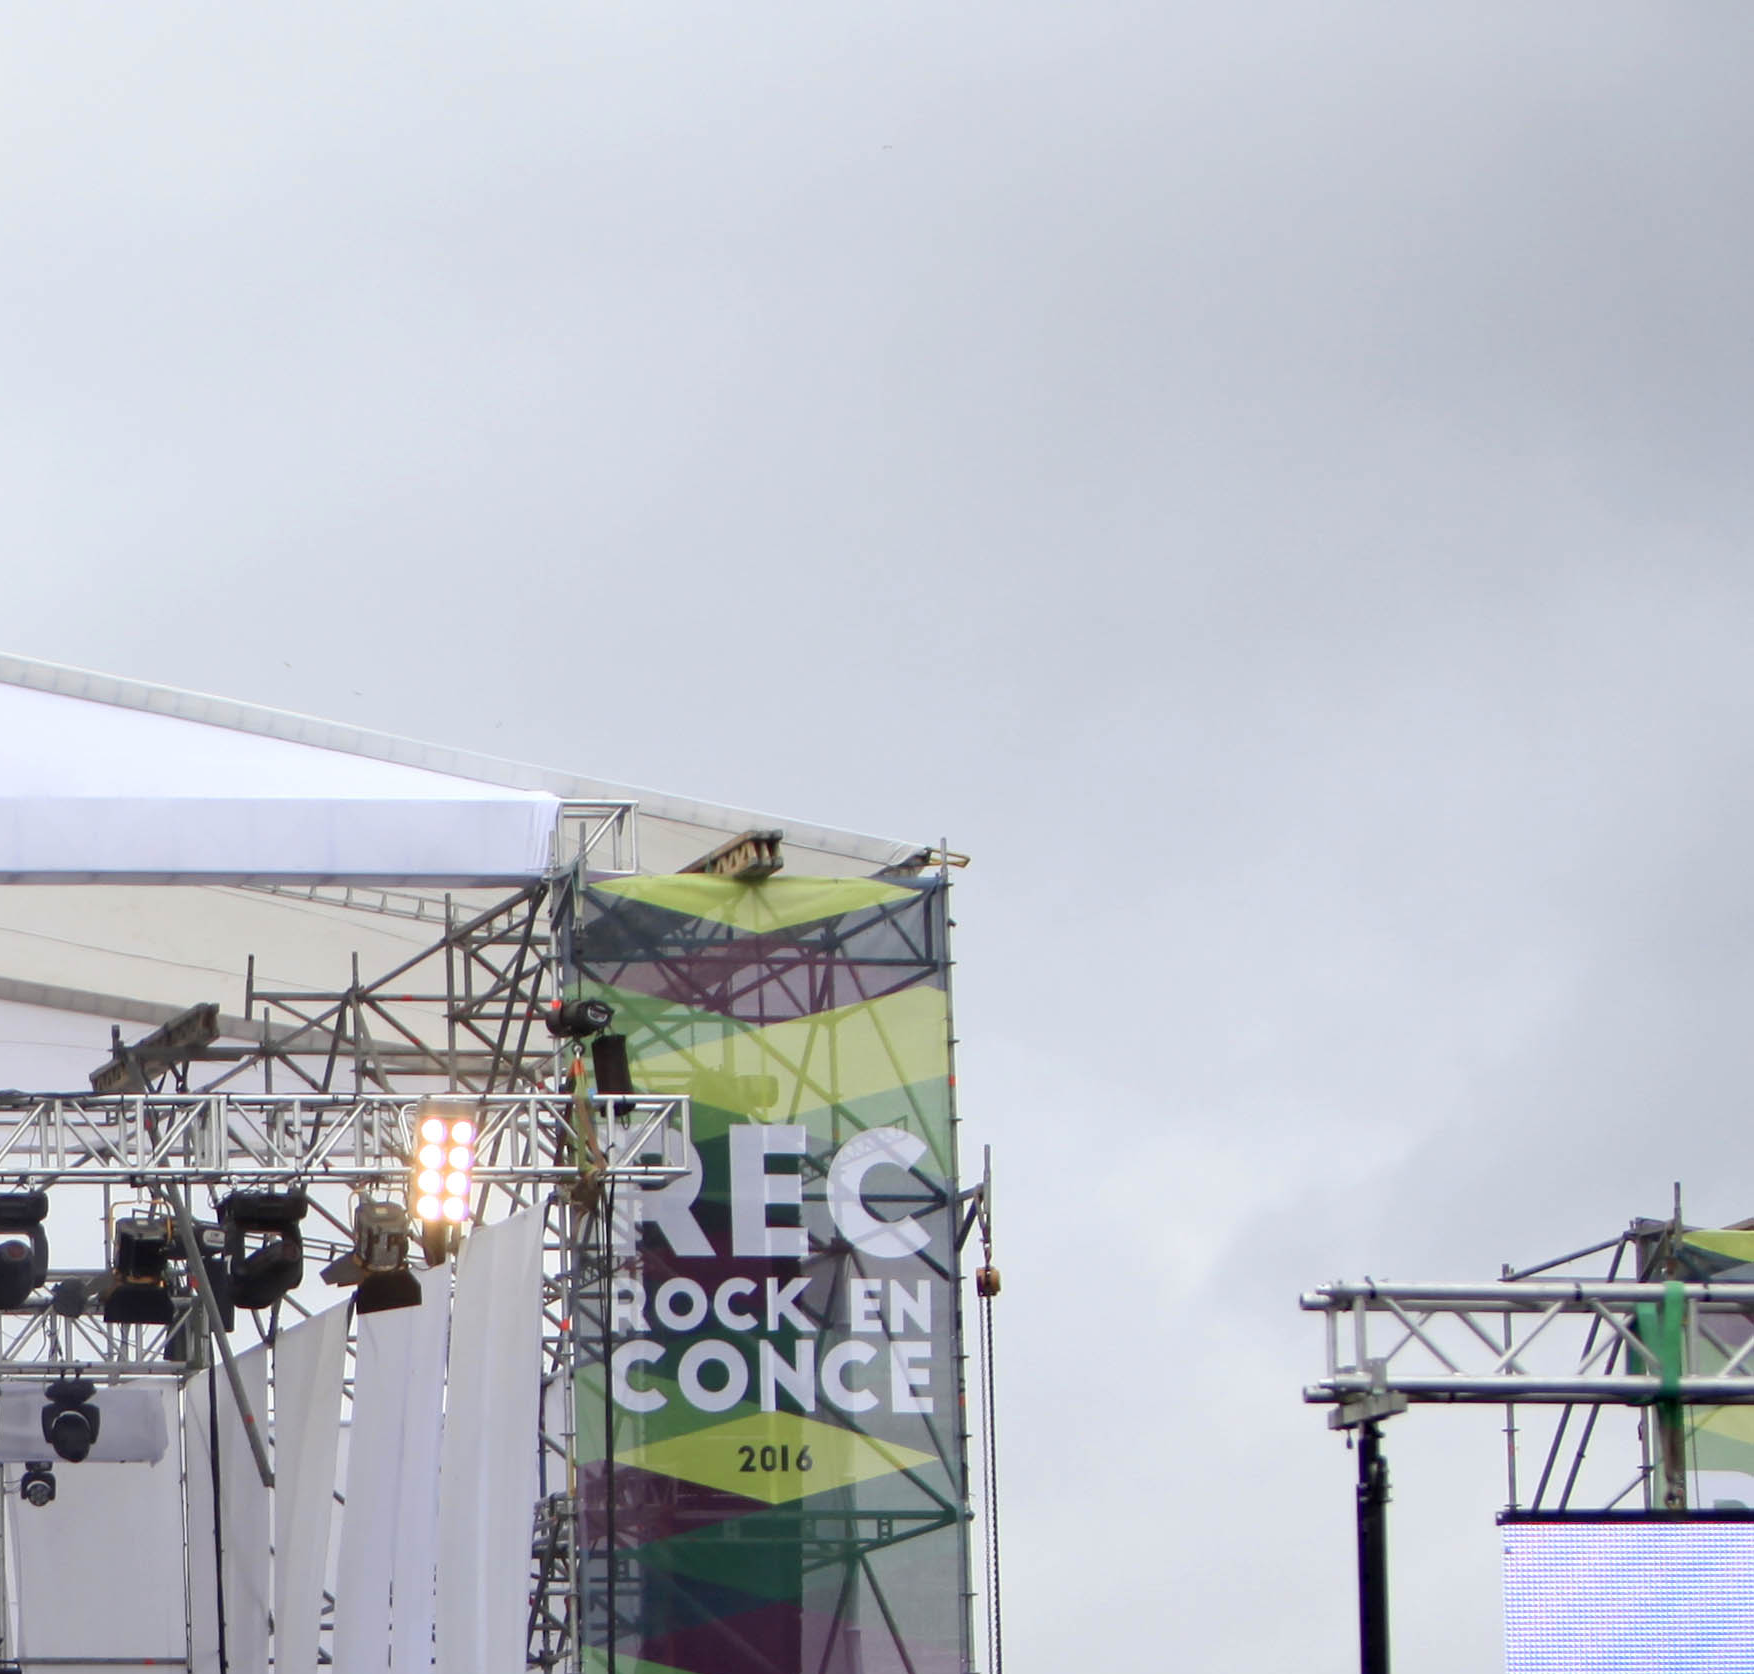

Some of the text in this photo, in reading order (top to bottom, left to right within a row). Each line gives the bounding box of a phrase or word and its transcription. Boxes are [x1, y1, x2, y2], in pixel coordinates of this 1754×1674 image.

[611, 1124, 933, 1258] REC
[611, 1276, 932, 1333] ROCK EN
[611, 1339, 934, 1414] CONCE
[738, 1445, 814, 1473] 2016
